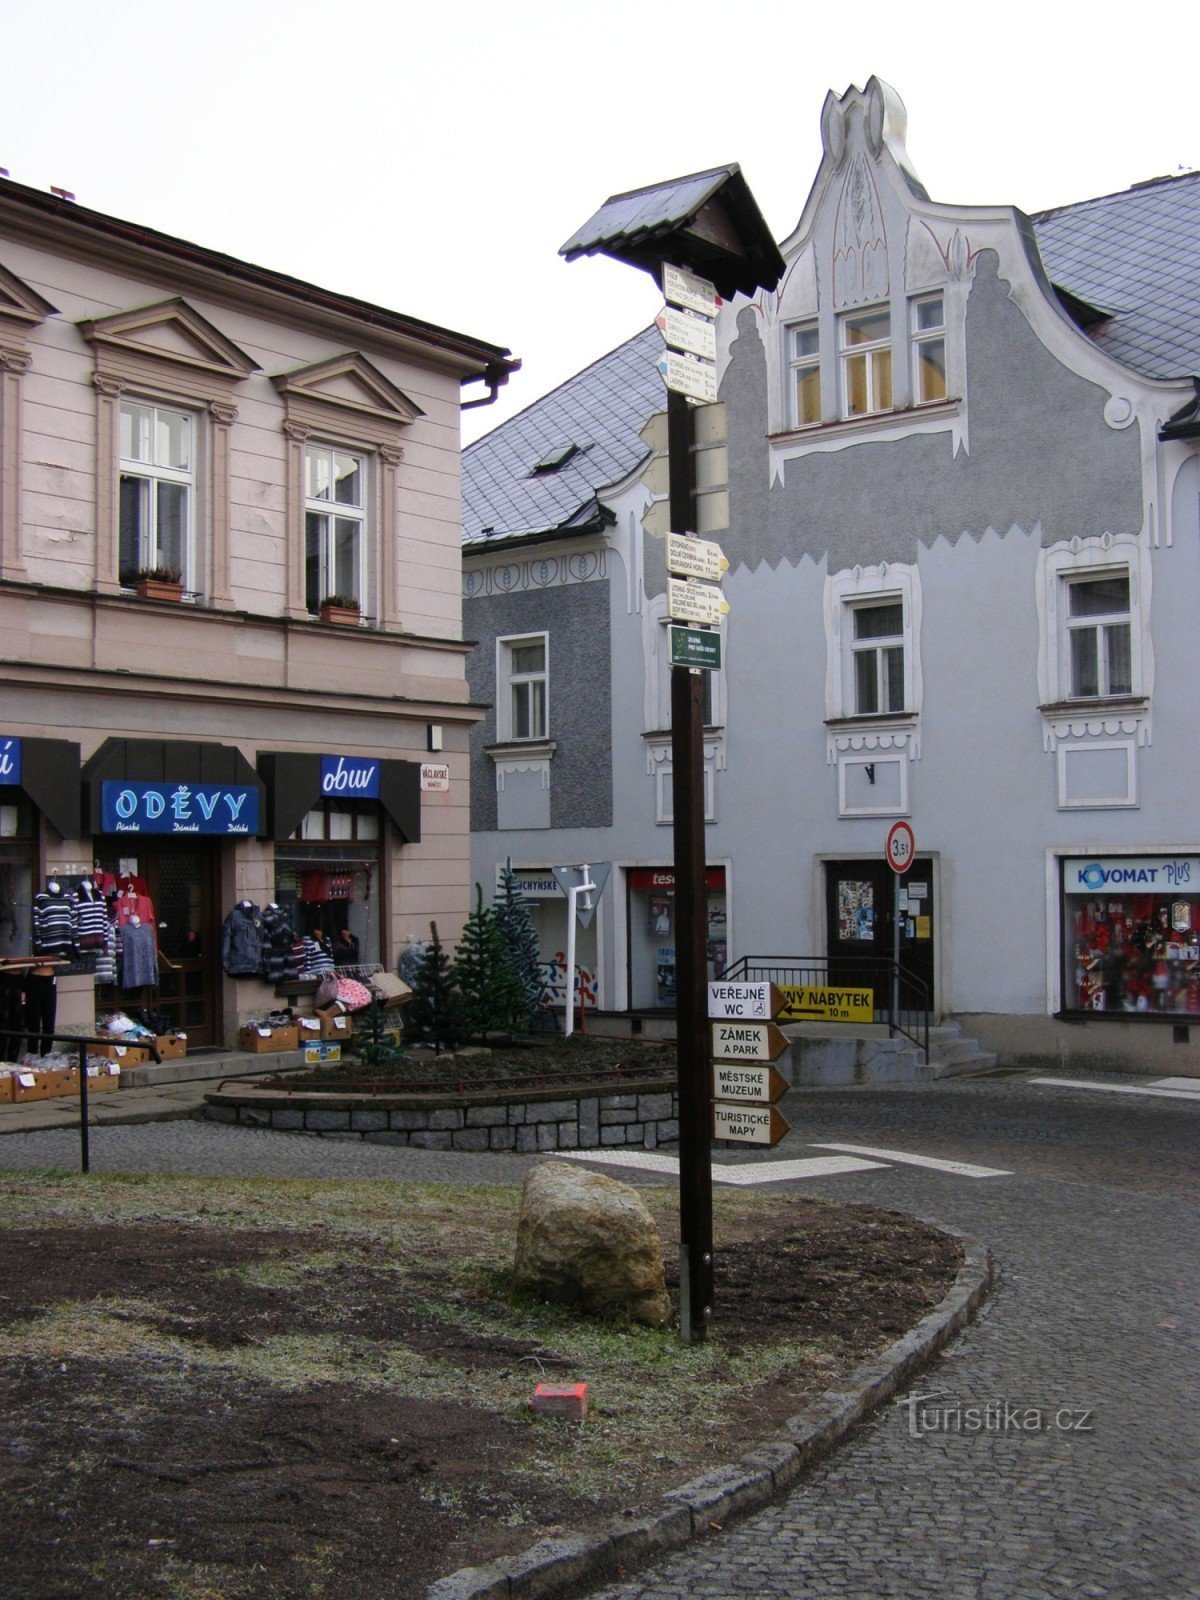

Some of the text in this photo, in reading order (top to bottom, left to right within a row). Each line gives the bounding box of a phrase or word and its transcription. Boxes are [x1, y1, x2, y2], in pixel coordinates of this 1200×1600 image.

[323, 757, 375, 791] obuv
[116, 785, 247, 821] ODĚVY
[1078, 866, 1158, 887] KOVOMAT
[712, 986, 766, 1000] VEŘEJNÉ
[725, 1004, 744, 1016] WC
[828, 1008, 849, 1018] 10 m
[720, 1027, 761, 1042] ZÁMEK
[724, 1045, 759, 1055] A PARK
[719, 1071, 764, 1084] MĚSTSKÉ
[721, 1085, 762, 1097] MUZEUM
[715, 1111, 770, 1125] TURISTICKÉ
[729, 1125, 756, 1137] MAPY
